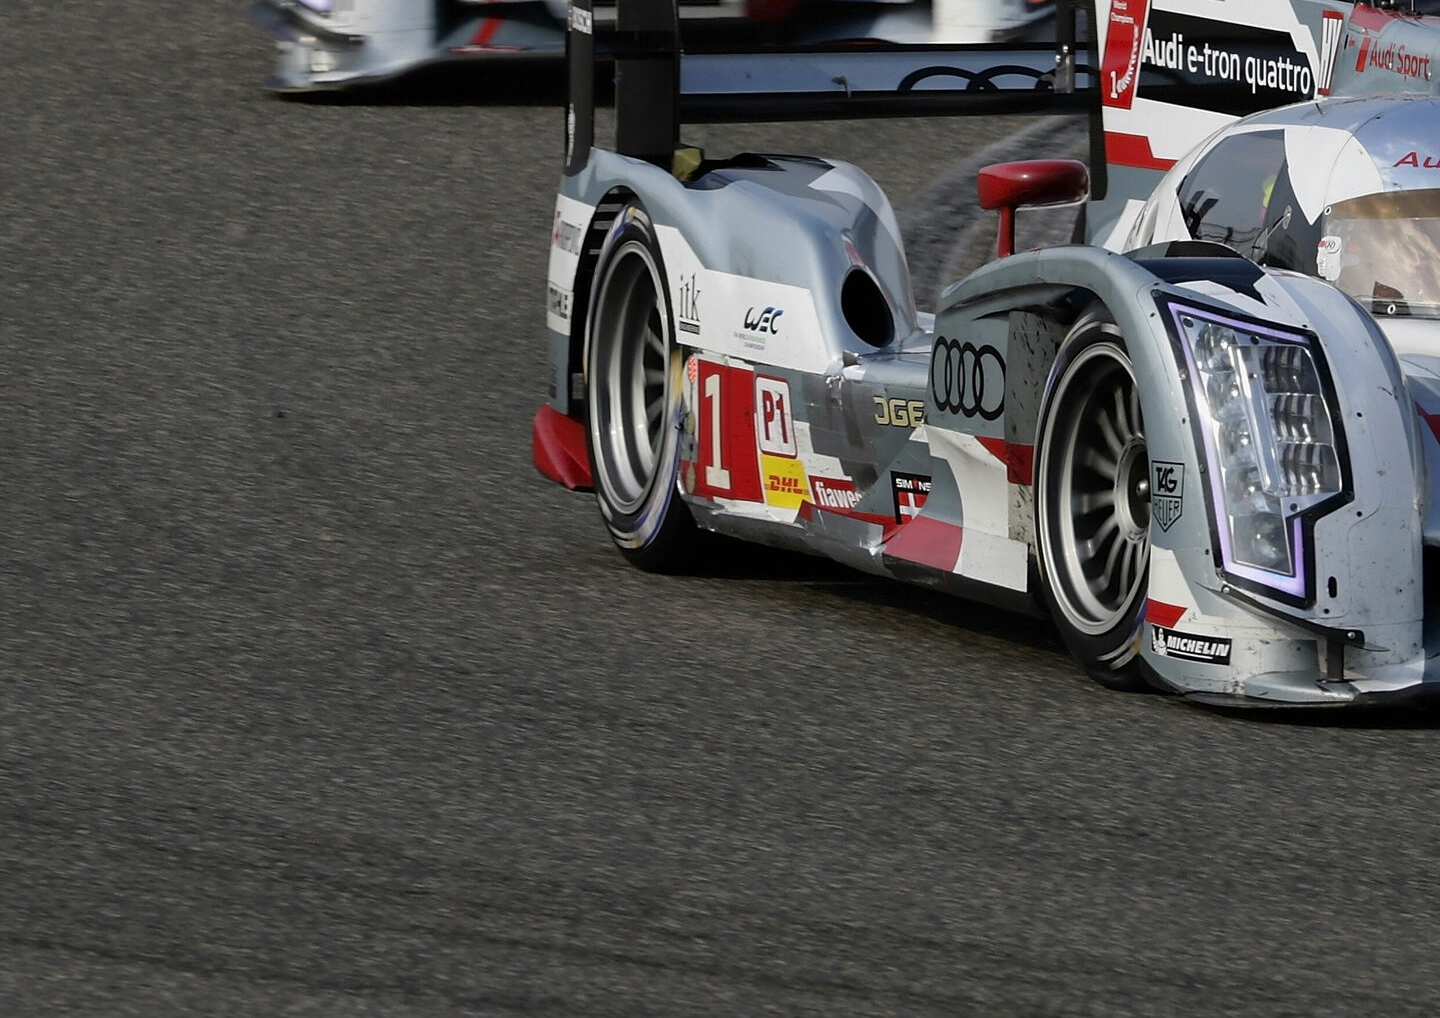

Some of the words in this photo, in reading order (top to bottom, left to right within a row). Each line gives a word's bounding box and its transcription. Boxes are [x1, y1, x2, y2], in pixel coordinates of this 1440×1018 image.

[1142, 28, 1183, 71] Audi
[1187, 43, 1241, 81] e-tron
[1245, 55, 1311, 94] quattro
[1369, 40, 1396, 71] Audi
[1397, 44, 1431, 81] Sport
[679, 272, 702, 322] itk
[743, 306, 784, 335] WEC
[705, 373, 731, 490] 1
[761, 389, 788, 444] P1
[768, 474, 800, 495] DHL
[1155, 467, 1178, 493] TAG
[1153, 498, 1180, 527] HEUER
[1166, 635, 1230, 657] MICHELIN
